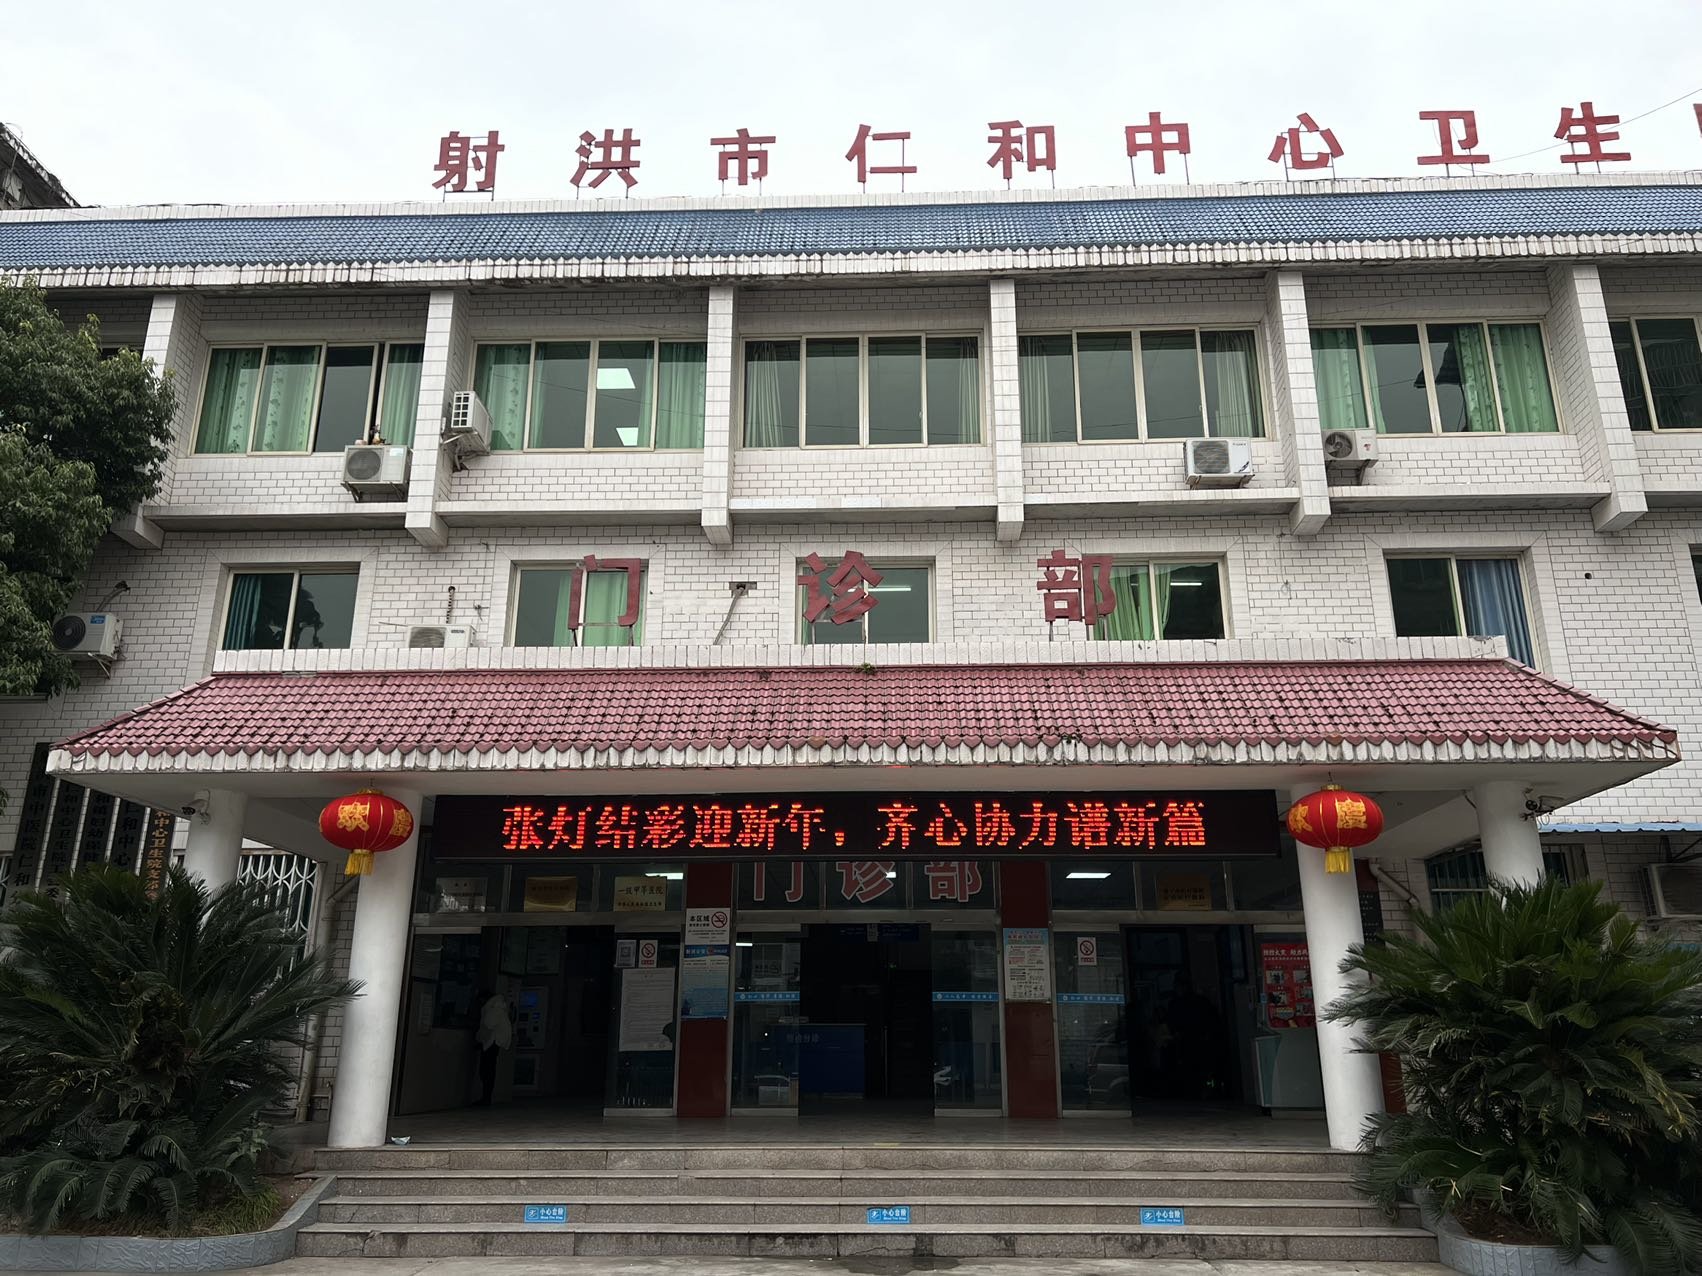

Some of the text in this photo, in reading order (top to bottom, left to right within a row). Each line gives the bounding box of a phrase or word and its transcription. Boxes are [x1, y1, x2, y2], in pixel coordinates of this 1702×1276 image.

[432, 101, 1702, 193] 射洪市仁和中心卫生
[567, 549, 1116, 628] 门诊部
[753, 861, 982, 904] 门诊部
[1156, 1210, 1180, 1218] 小心台阶
